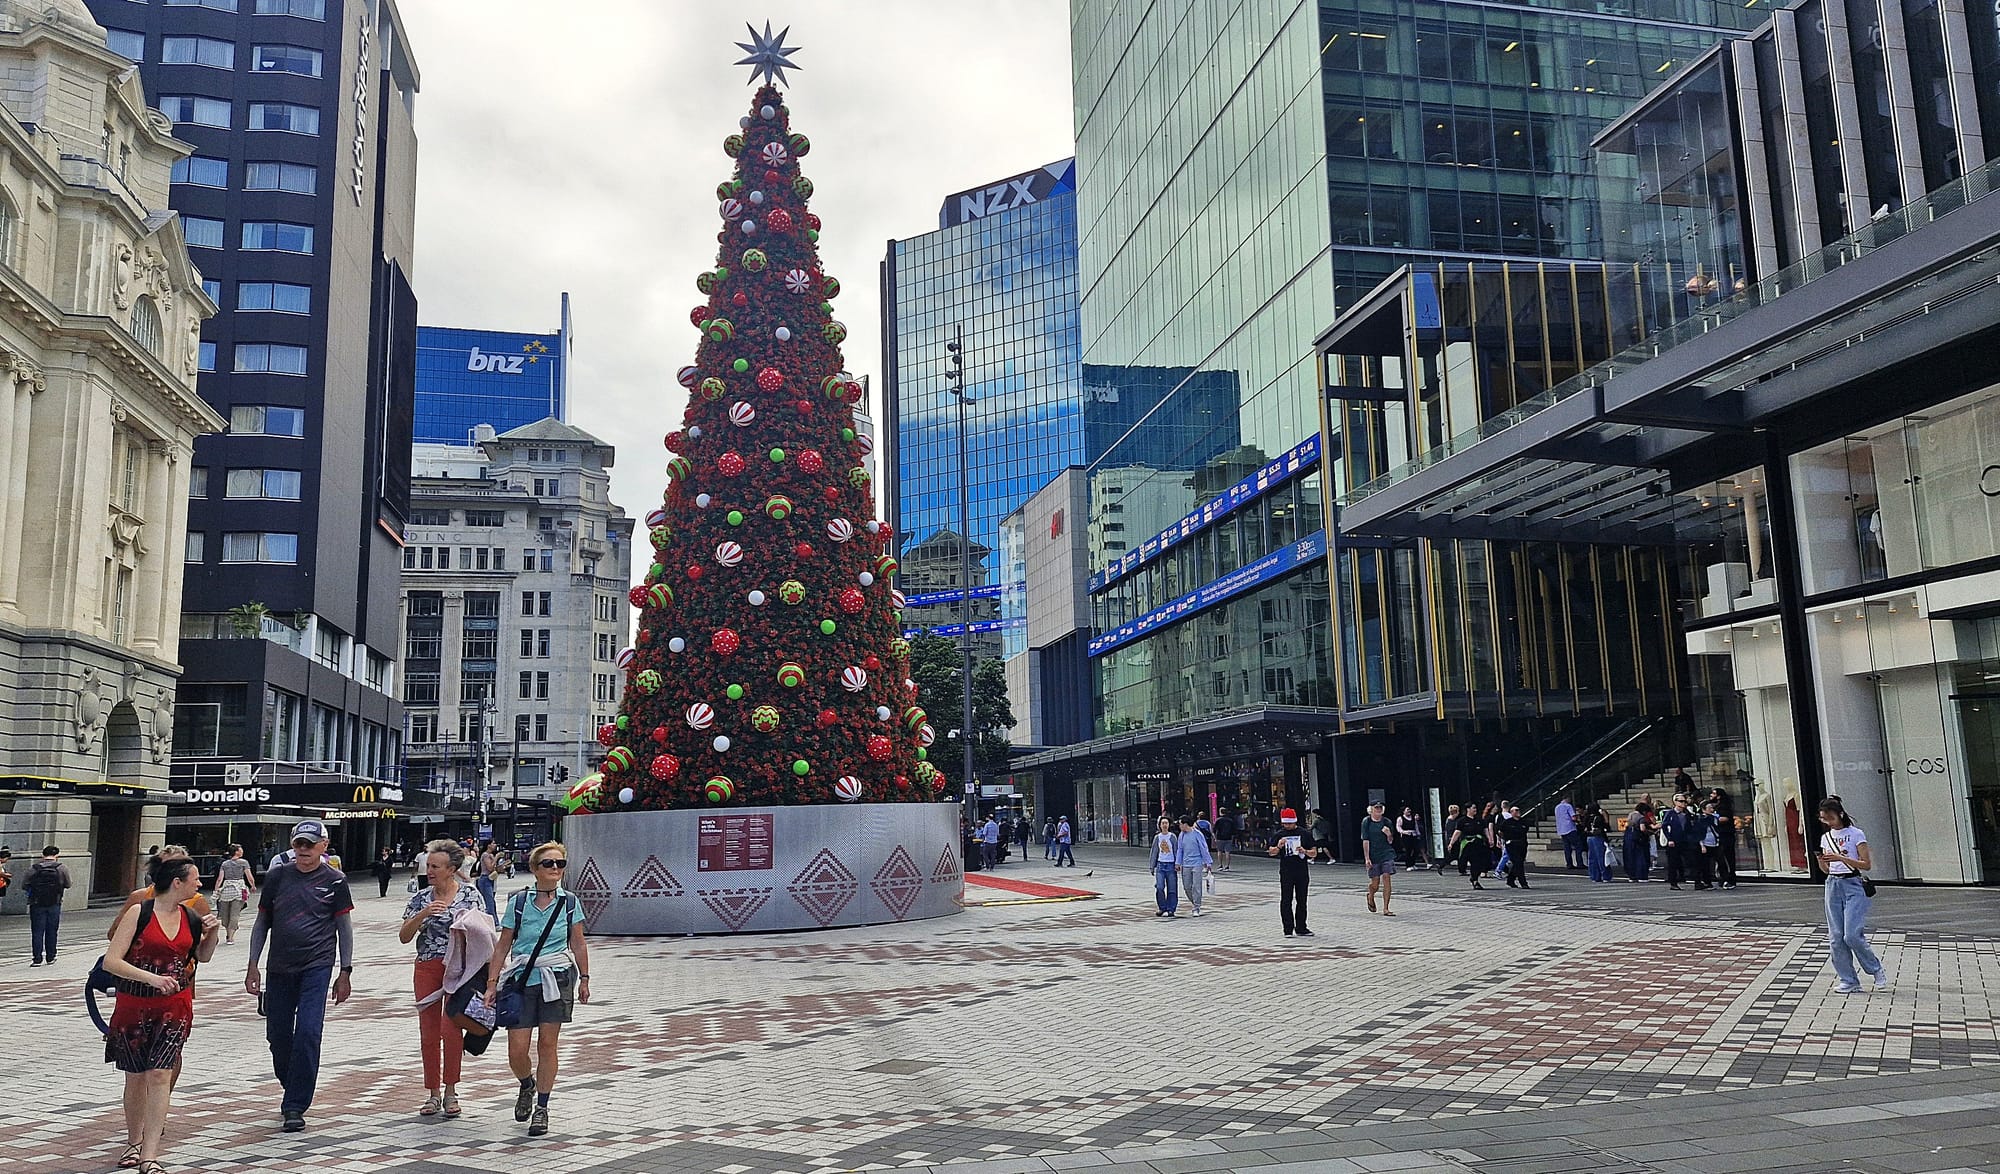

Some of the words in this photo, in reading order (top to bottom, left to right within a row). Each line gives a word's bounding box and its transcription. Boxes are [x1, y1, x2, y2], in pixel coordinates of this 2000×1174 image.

[960, 174, 1037, 223] NZX
[467, 346, 525, 374] bnz
[1299, 441, 1314, 456] $1.40
[1198, 768, 1214, 776] COACH
[1906, 758, 1945, 775] COS
[167, 788, 270, 802] Donald's
[325, 811, 379, 819] McDonald's
